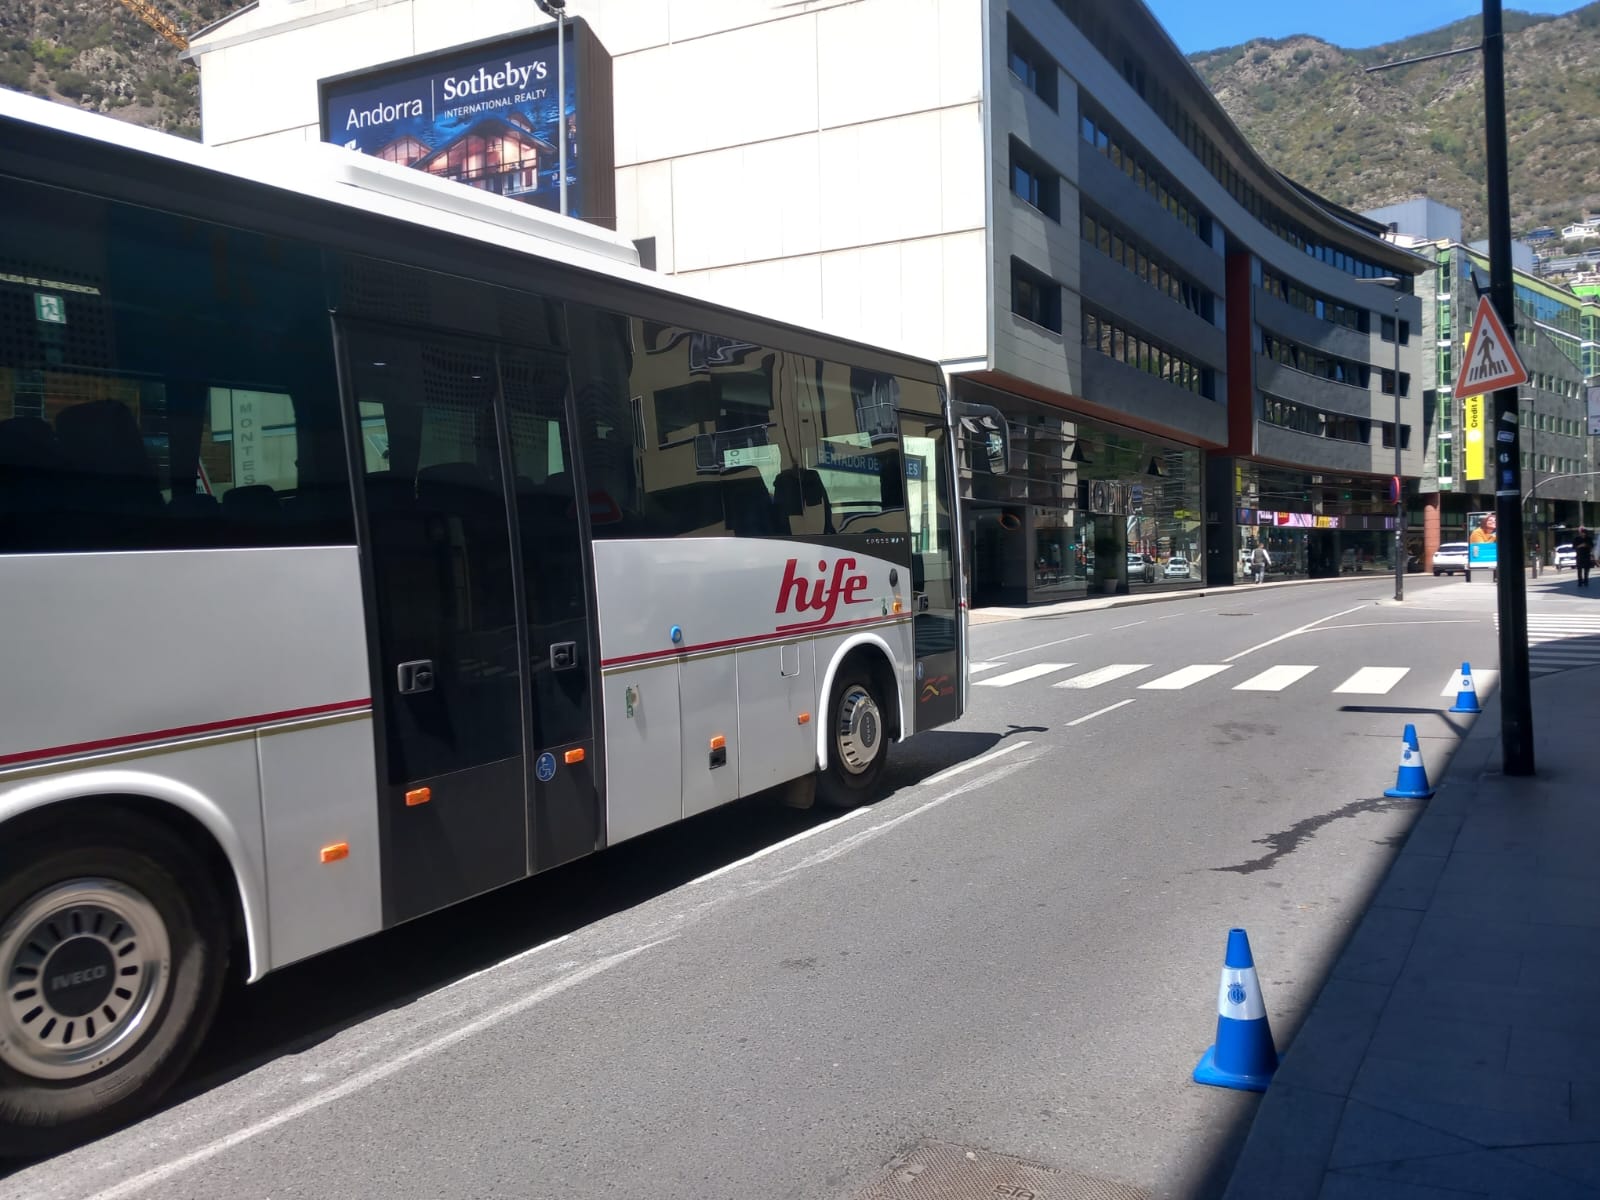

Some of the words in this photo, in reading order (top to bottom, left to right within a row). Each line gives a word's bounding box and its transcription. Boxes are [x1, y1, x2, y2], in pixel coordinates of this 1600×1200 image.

[443, 60, 548, 101] Sotheby's
[346, 98, 423, 131] Andorra
[444, 96, 512, 119] INTERNATIONAL
[514, 88, 547, 104] REALTY
[775, 557, 873, 631] hife
[51, 965, 107, 990] IVECO
